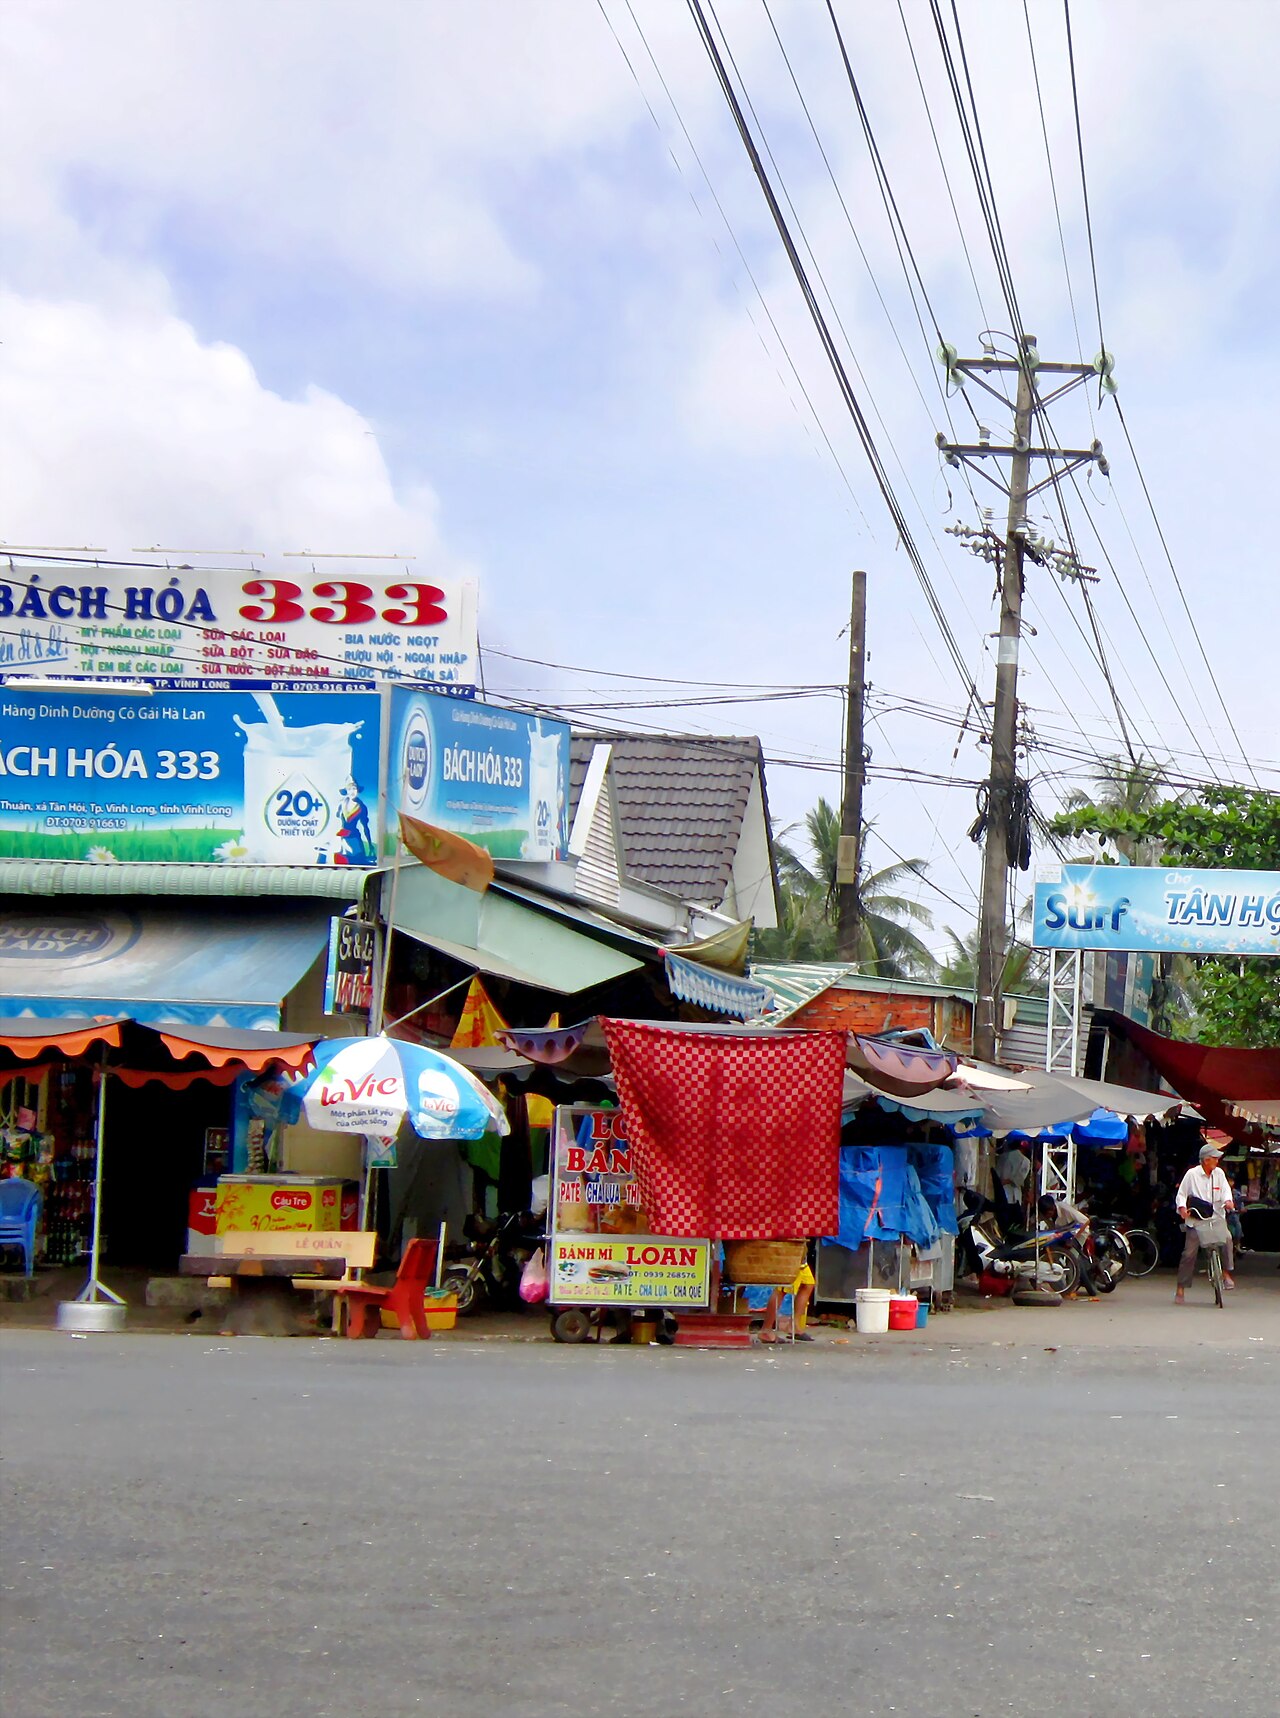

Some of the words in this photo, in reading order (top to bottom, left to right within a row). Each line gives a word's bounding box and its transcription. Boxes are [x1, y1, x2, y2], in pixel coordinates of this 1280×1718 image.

[123, 577, 217, 622] HÓA
[239, 579, 448, 626] 333
[134, 625, 155, 640] CÁC
[158, 627, 182, 641] LOẠI
[260, 631, 286, 643] LOẠI
[345, 633, 364, 645] BIA
[369, 632, 401, 646] NƯỚC
[407, 636, 439, 649] NGỌT
[230, 645, 255, 660] BỘT
[377, 649, 393, 665] NỘI
[405, 651, 434, 665] NGOẠI
[439, 652, 468, 666] NHẬP
[98, 660, 114, 673] EM
[118, 659, 132, 673] BÉ
[135, 659, 157, 674] CÁC
[161, 663, 184, 676] LOẠI
[154, 680, 171, 688] TP.
[202, 680, 230, 690] LONG
[271, 682, 289, 690] ĐT:
[3, 704, 36, 721] Hàng
[40, 705, 69, 718] Dinh
[73, 705, 115, 722] Dưỡng
[118, 706, 135, 720] Cô
[138, 707, 159, 720] Gái
[163, 707, 179, 721] Hà
[183, 708, 206, 720] Lan
[0, 741, 57, 777] CH
[67, 743, 148, 779] HÓA
[156, 750, 220, 780] 333
[443, 742, 475, 783] BÁCH
[477, 746, 502, 785] HÓA
[503, 756, 523, 788] 333
[49, 801, 67, 812] Tân
[130, 804, 157, 816] Long,
[206, 806, 232, 817] Long
[276, 790, 323, 817] 20+
[89, 818, 127, 830] 916619
[1164, 872, 1194, 885] Chợ
[1046, 893, 1132, 933] Surf
[1166, 888, 1233, 925] TÂN
[565, 1141, 633, 1174] BÁN
[293, 1196, 308, 1206] Tre
[558, 1244, 595, 1261] BÁNH
[625, 1246, 698, 1267] LOAN
[643, 1271, 664, 1279] 0939
[666, 1272, 696, 1280] 268576
[613, 1284, 623, 1296] PA
